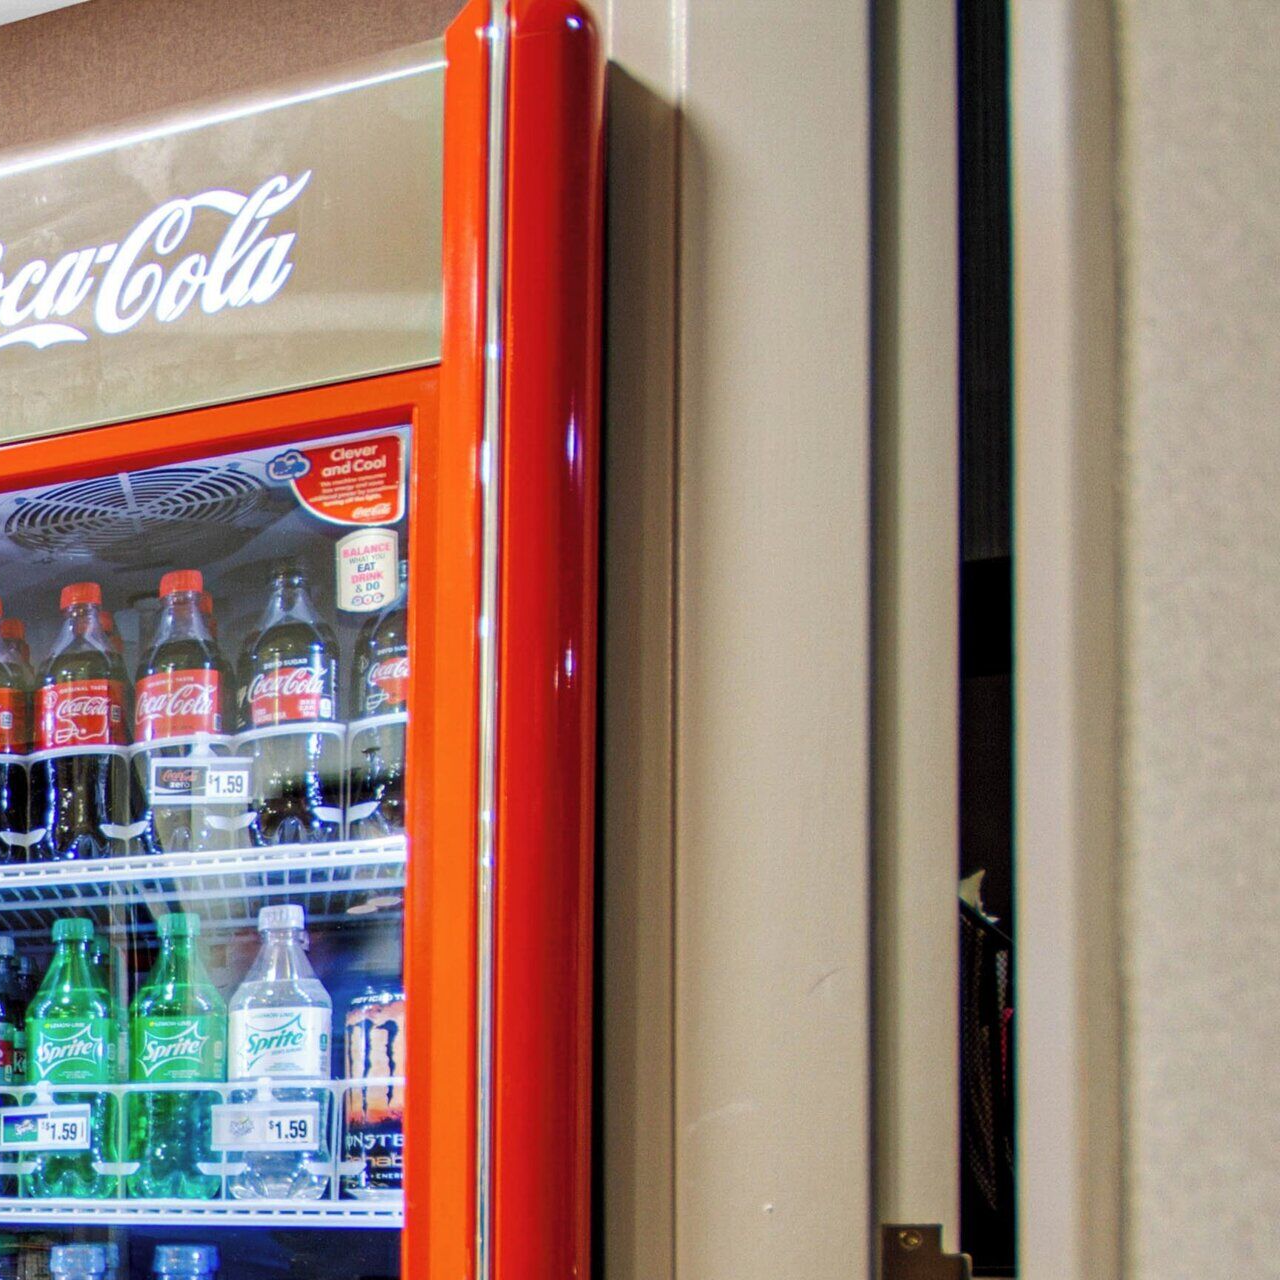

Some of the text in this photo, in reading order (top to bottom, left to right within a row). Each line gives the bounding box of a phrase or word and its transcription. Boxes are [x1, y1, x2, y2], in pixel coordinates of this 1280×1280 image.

[330, 444, 378, 462] Clever
[321, 454, 387, 478] and Cool
[342, 543, 390, 559] BALANCE
[357, 562, 376, 573] EAT
[351, 572, 384, 585] DRINK
[355, 580, 380, 593] & DO
[283, 658, 308, 667] SUGAR
[248, 666, 328, 703] Coca-Cola
[135, 684, 217, 724] Coca-Cola
[208, 774, 244, 793] $1.59
[37, 1038, 93, 1063] Sprite
[143, 1037, 200, 1062] Sprite
[247, 1030, 303, 1055] Sprite
[44, 1121, 78, 1141] $1.59
[269, 1119, 308, 1139] $1.59
